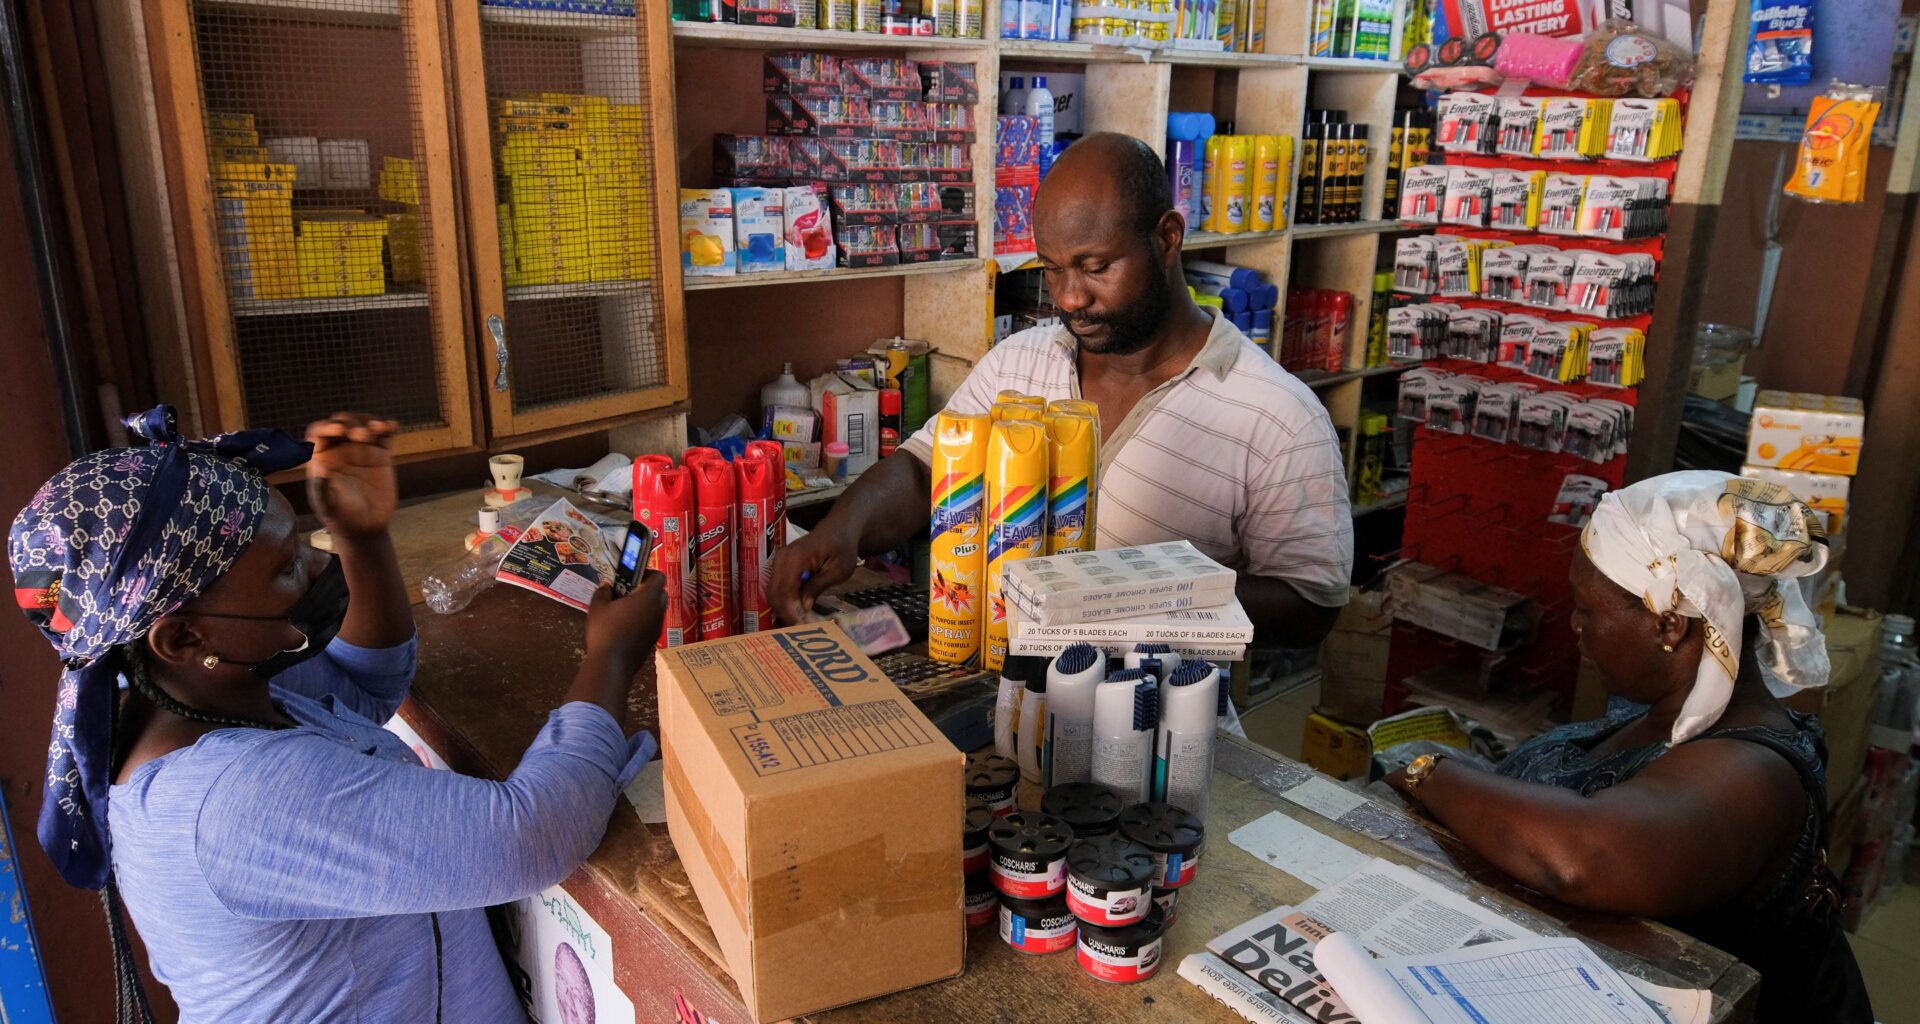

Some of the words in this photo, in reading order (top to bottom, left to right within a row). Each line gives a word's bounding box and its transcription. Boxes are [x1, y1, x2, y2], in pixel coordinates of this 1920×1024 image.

[1493, 0, 1565, 27] LASTING
[1752, 5, 1808, 22] Gillette
[1769, 18, 1795, 29] Blue
[1449, 102, 1491, 116] Energizer
[1504, 107, 1539, 119] Energizer
[1546, 108, 1585, 122] Energizer
[1613, 109, 1654, 122] Energizer
[1406, 175, 1446, 190] Energizer
[1450, 176, 1491, 190] Energizer
[1811, 172, 1821, 186] 1
[243, 182, 283, 192] HEAVEN
[1494, 183, 1529, 196] Energizer
[1544, 185, 1582, 199] Energizer
[1588, 188, 1637, 201] Energizer
[1484, 258, 1513, 269] Energizer
[1529, 264, 1558, 274] Energizer
[1576, 266, 1623, 277] Energizer
[1503, 326, 1534, 337] Energiz
[1532, 335, 1568, 346] Energizer
[1590, 341, 1625, 352] Energizer
[933, 505, 982, 525] HEAVEN
[1049, 513, 1086, 530] AVEN
[698, 524, 725, 543] asso
[993, 521, 1044, 541] HEAVEN
[954, 543, 977, 556] Plus
[1149, 585, 1173, 596] SUPER
[1176, 582, 1193, 592] 100
[1082, 591, 1113, 602] BLADES
[1116, 589, 1147, 599] CHROME
[1149, 601, 1173, 611] SUPER
[1176, 596, 1193, 608] 100
[1081, 608, 1112, 618] BLADES
[1115, 604, 1146, 615] CHROME
[702, 619, 725, 633] LLER
[935, 616, 957, 626] PURPOSE
[957, 617, 976, 626] INSECT
[930, 625, 973, 640] SPRAY
[1027, 628, 1036, 636] 20
[1037, 628, 1061, 637] TUCKS
[1061, 628, 1072, 637] OF
[1073, 629, 1078, 637] 5
[1078, 629, 1108, 638] BLADES
[1108, 629, 1128, 638] EACH
[1146, 630, 1155, 638] 20
[1156, 630, 1179, 639] TUCKS
[1180, 631, 1191, 639] OF
[1191, 631, 1196, 639] 5
[1197, 631, 1225, 640] BLADES
[1226, 631, 1246, 640] EACH
[944, 637, 970, 649] FORMULA
[1019, 644, 1028, 652] 20
[1029, 644, 1052, 653] TUCKS
[1053, 644, 1063, 652] OF
[786, 627, 868, 684] LORD
[1183, 648, 1188, 656] 5
[1188, 648, 1216, 657] BLADES
[1217, 649, 1237, 658] EACH
[802, 669, 836, 700] BLADES
[741, 732, 783, 769] L155-A12
[999, 855, 1036, 871] COSCHARIS
[1088, 937, 1126, 955] COSCHARIS
[1252, 923, 1326, 983] Na
[1200, 964, 1223, 982] govt
[1221, 939, 1361, 1024] Deliv
[1222, 979, 1250, 1000] urge
[1246, 994, 1282, 1020] rulers
